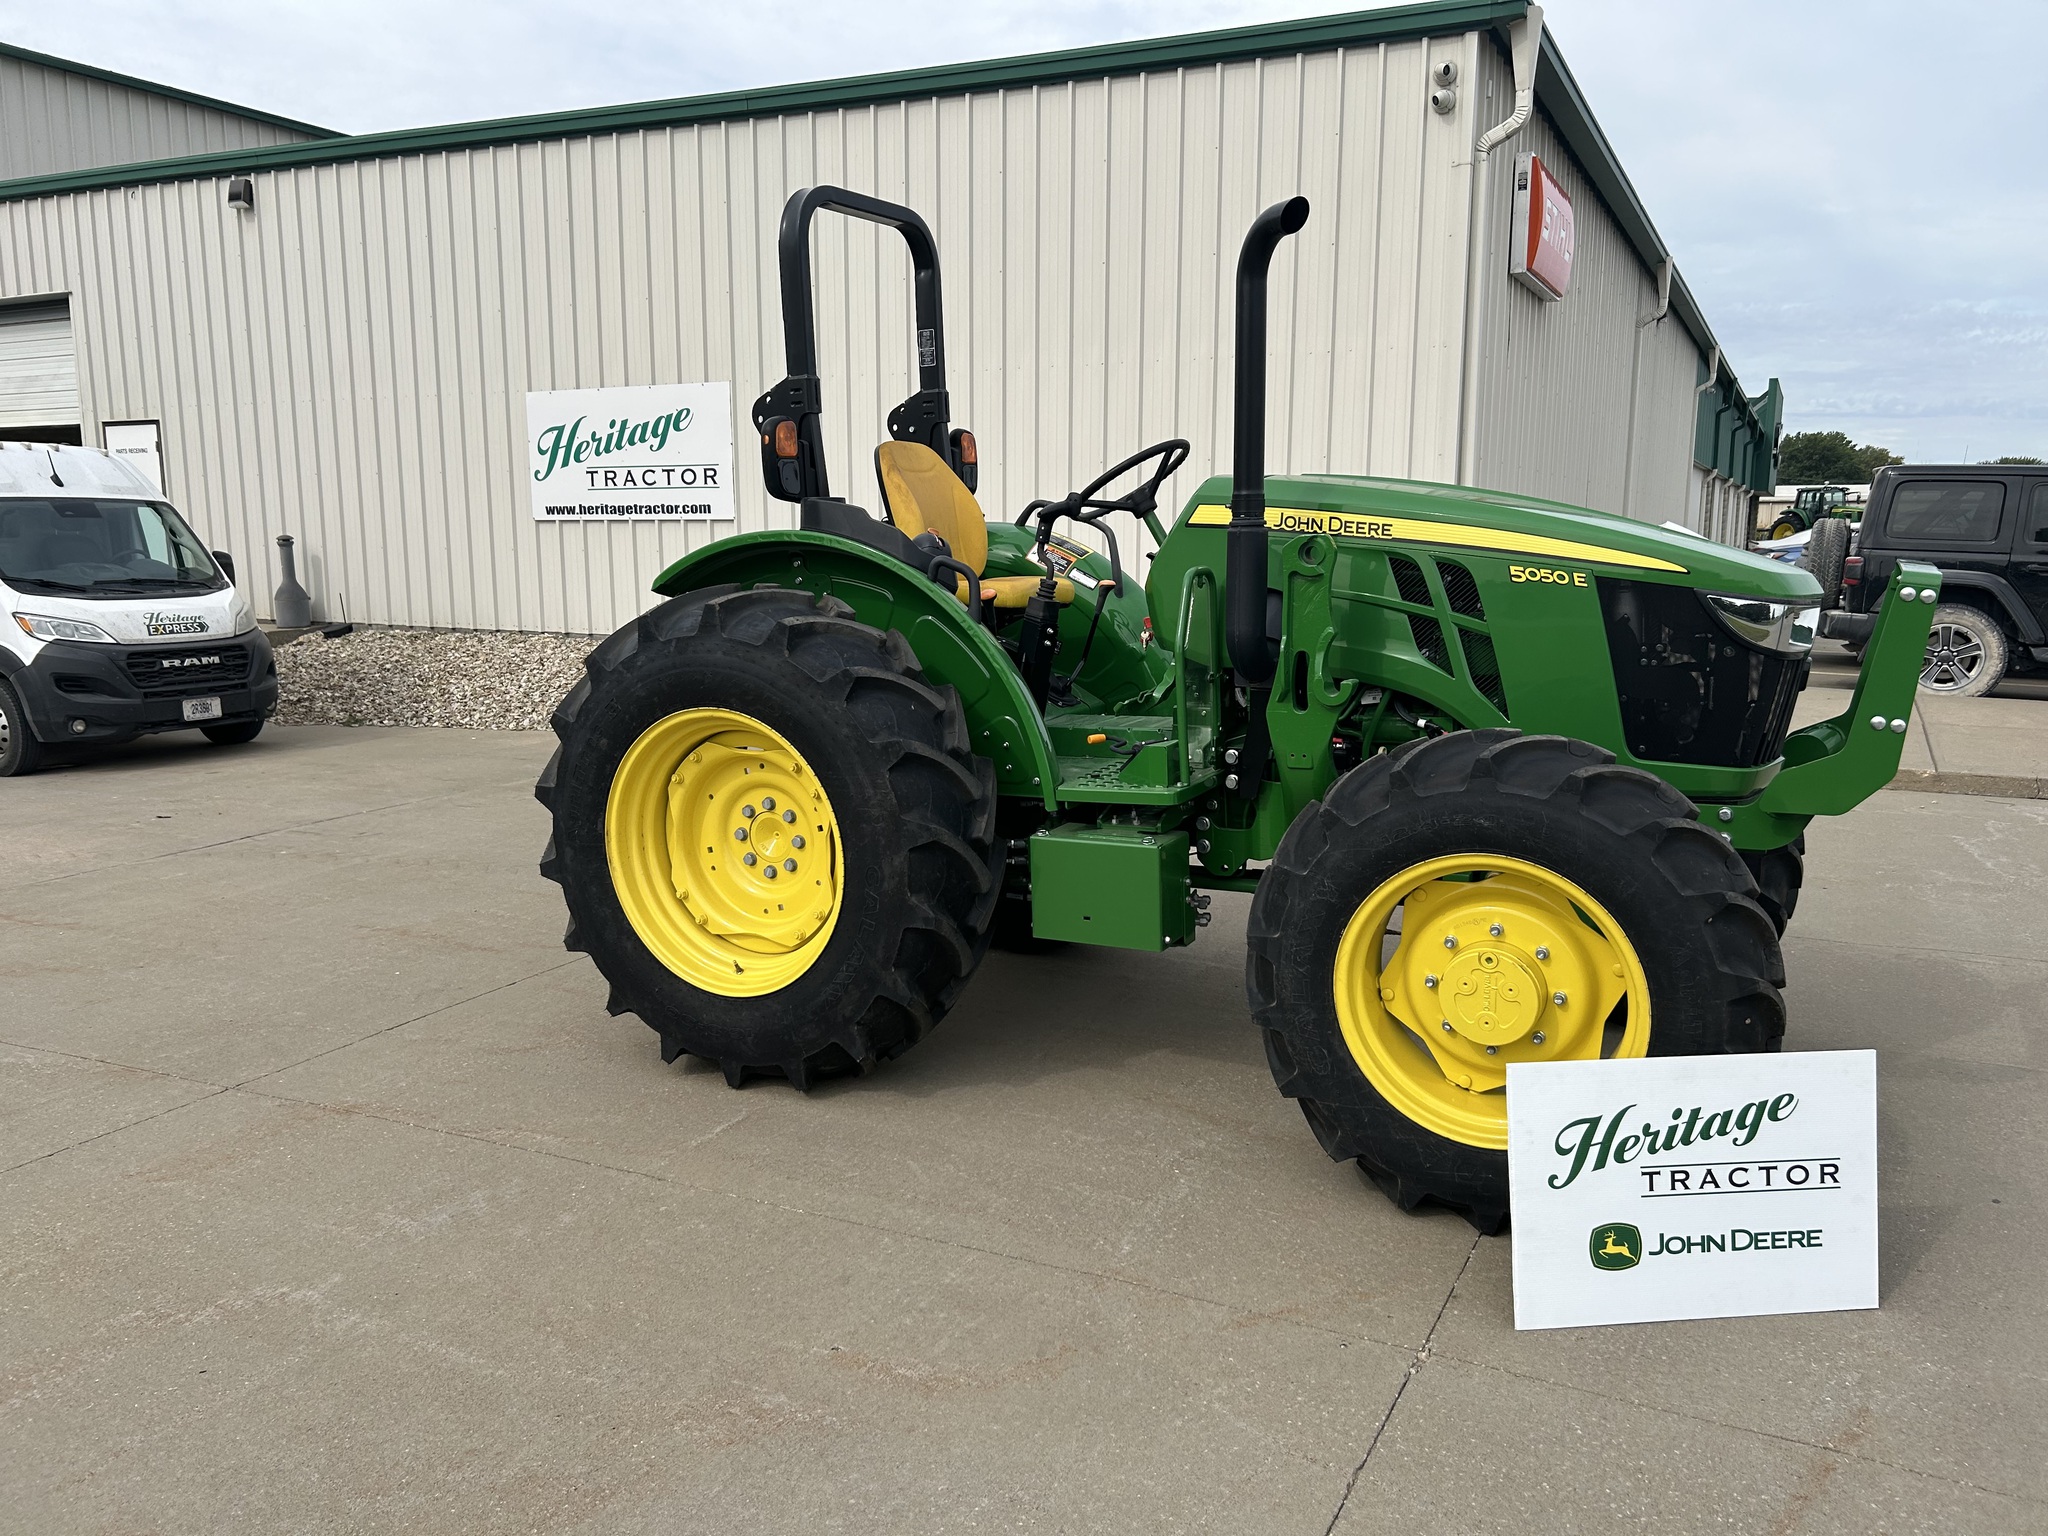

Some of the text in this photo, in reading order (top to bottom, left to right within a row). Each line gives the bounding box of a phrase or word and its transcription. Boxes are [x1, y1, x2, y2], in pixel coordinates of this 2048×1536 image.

[1542, 197, 1571, 262] STIHL
[534, 407, 694, 482] Heritage
[586, 467, 718, 487] TRACTOR
[545, 503, 711, 516] www.heritagetractor.com
[1273, 512, 1393, 537] JOHN DEERE
[1508, 565, 1588, 587] 5050 E
[143, 612, 205, 625] Heritage
[150, 623, 201, 635] EXPRESS
[162, 656, 220, 668] RAM
[1548, 1092, 1799, 1190] Heritage
[1641, 1163, 1840, 1192] TRACTOR
[1649, 1228, 1823, 1256] JOHN DEERE
